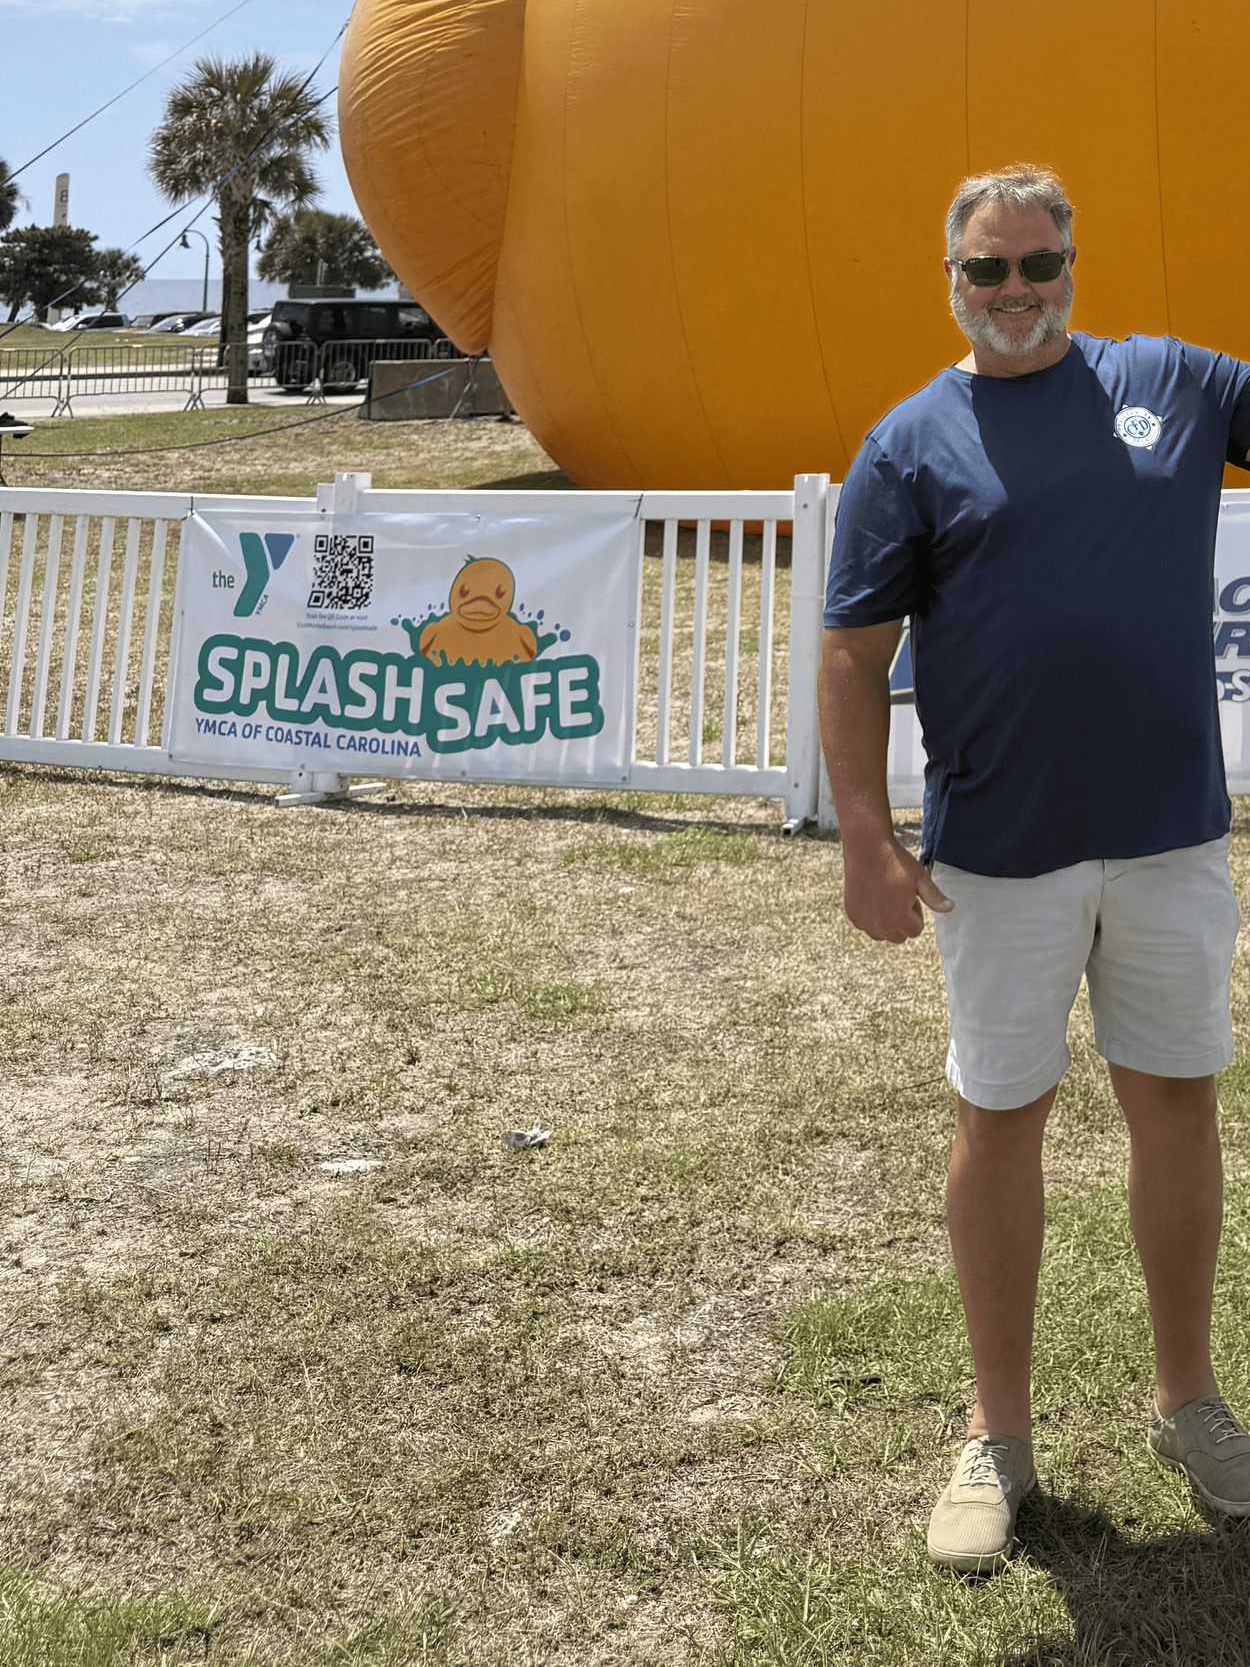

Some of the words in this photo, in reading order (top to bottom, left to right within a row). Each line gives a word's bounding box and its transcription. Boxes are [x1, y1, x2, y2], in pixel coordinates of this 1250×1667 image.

[59, 189, 69, 203] 8
[212, 569, 235, 589] the
[255, 594, 269, 615] YMCA
[202, 645, 424, 725] SPLASH
[433, 666, 593, 743] SAFE
[195, 717, 238, 738] YMCA
[241, 723, 263, 740] OF
[265, 725, 332, 749] COASTAL
[336, 734, 422, 758] CAROLINA
